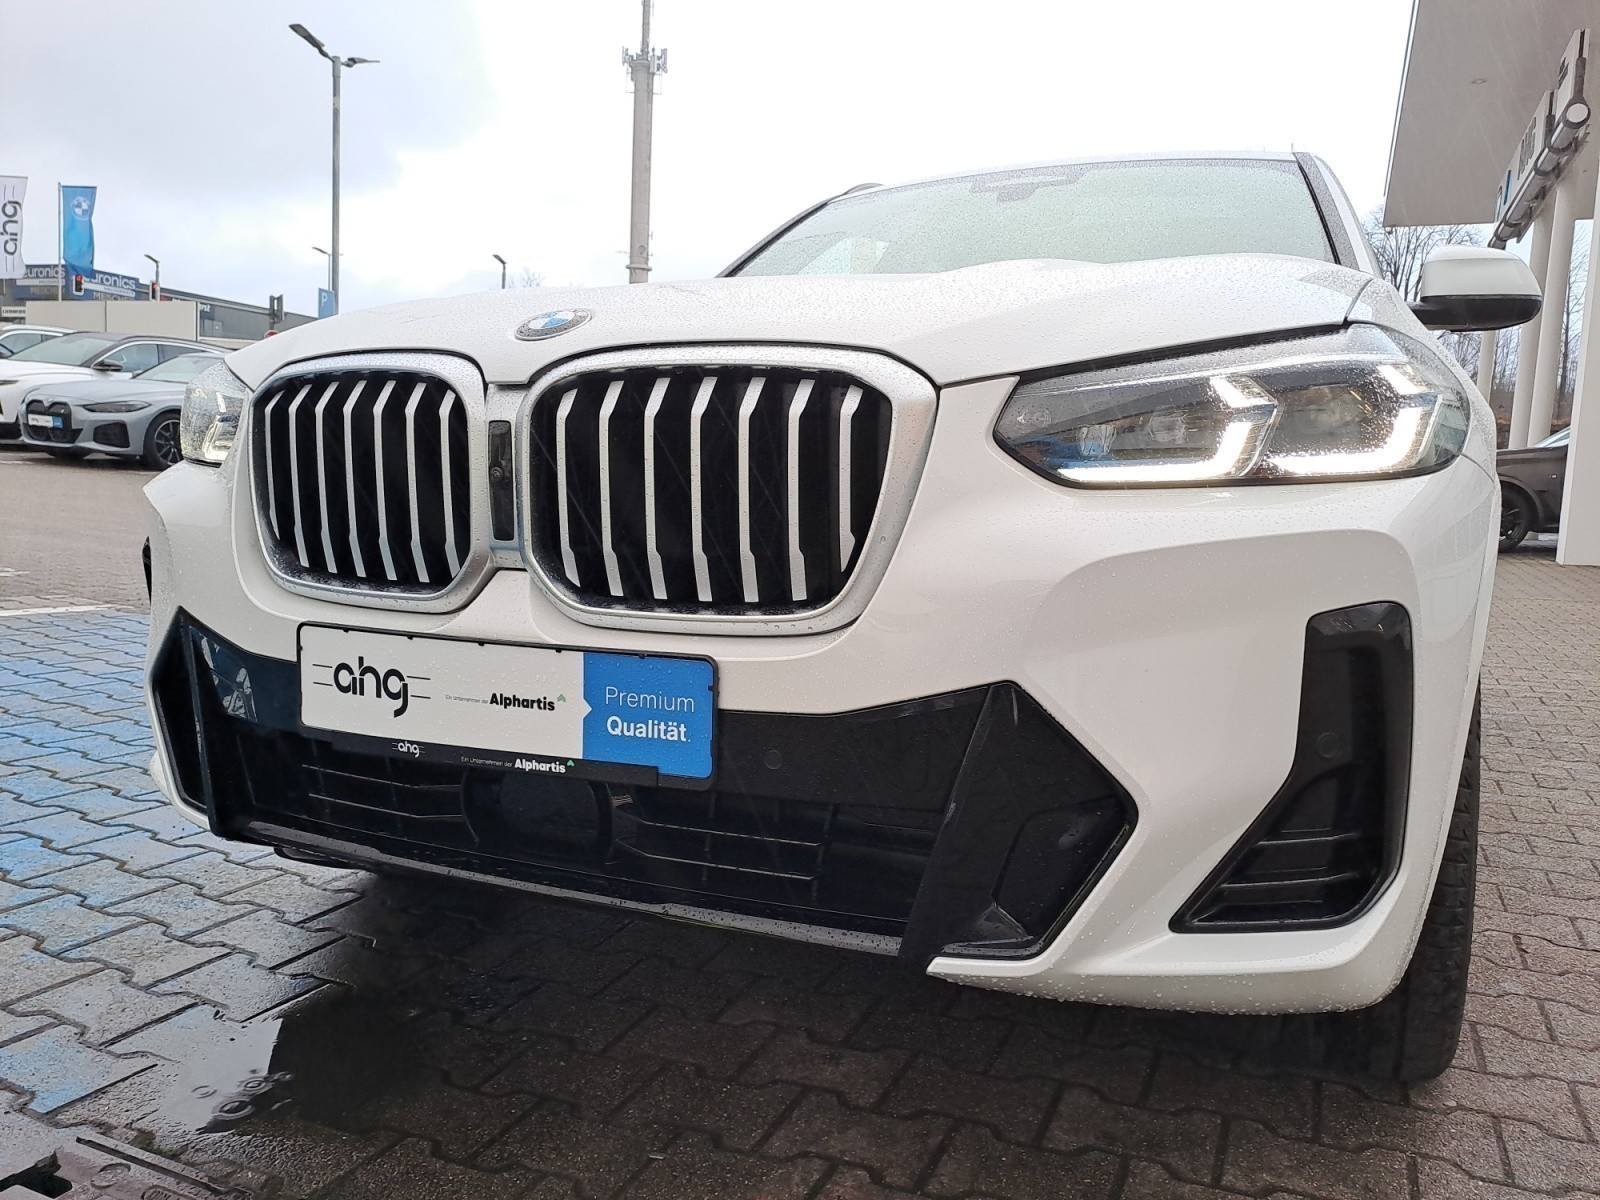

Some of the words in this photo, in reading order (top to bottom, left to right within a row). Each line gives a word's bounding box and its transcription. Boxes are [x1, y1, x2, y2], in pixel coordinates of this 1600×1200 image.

[0, 200, 22, 256] ahg
[86, 273, 136, 289] uronics
[320, 292, 328, 307] P
[333, 656, 409, 718] ahg
[489, 693, 555, 711] Alphartis
[605, 686, 695, 713] Premium
[398, 741, 420, 758] ahg
[514, 758, 566, 773] Alphartis
